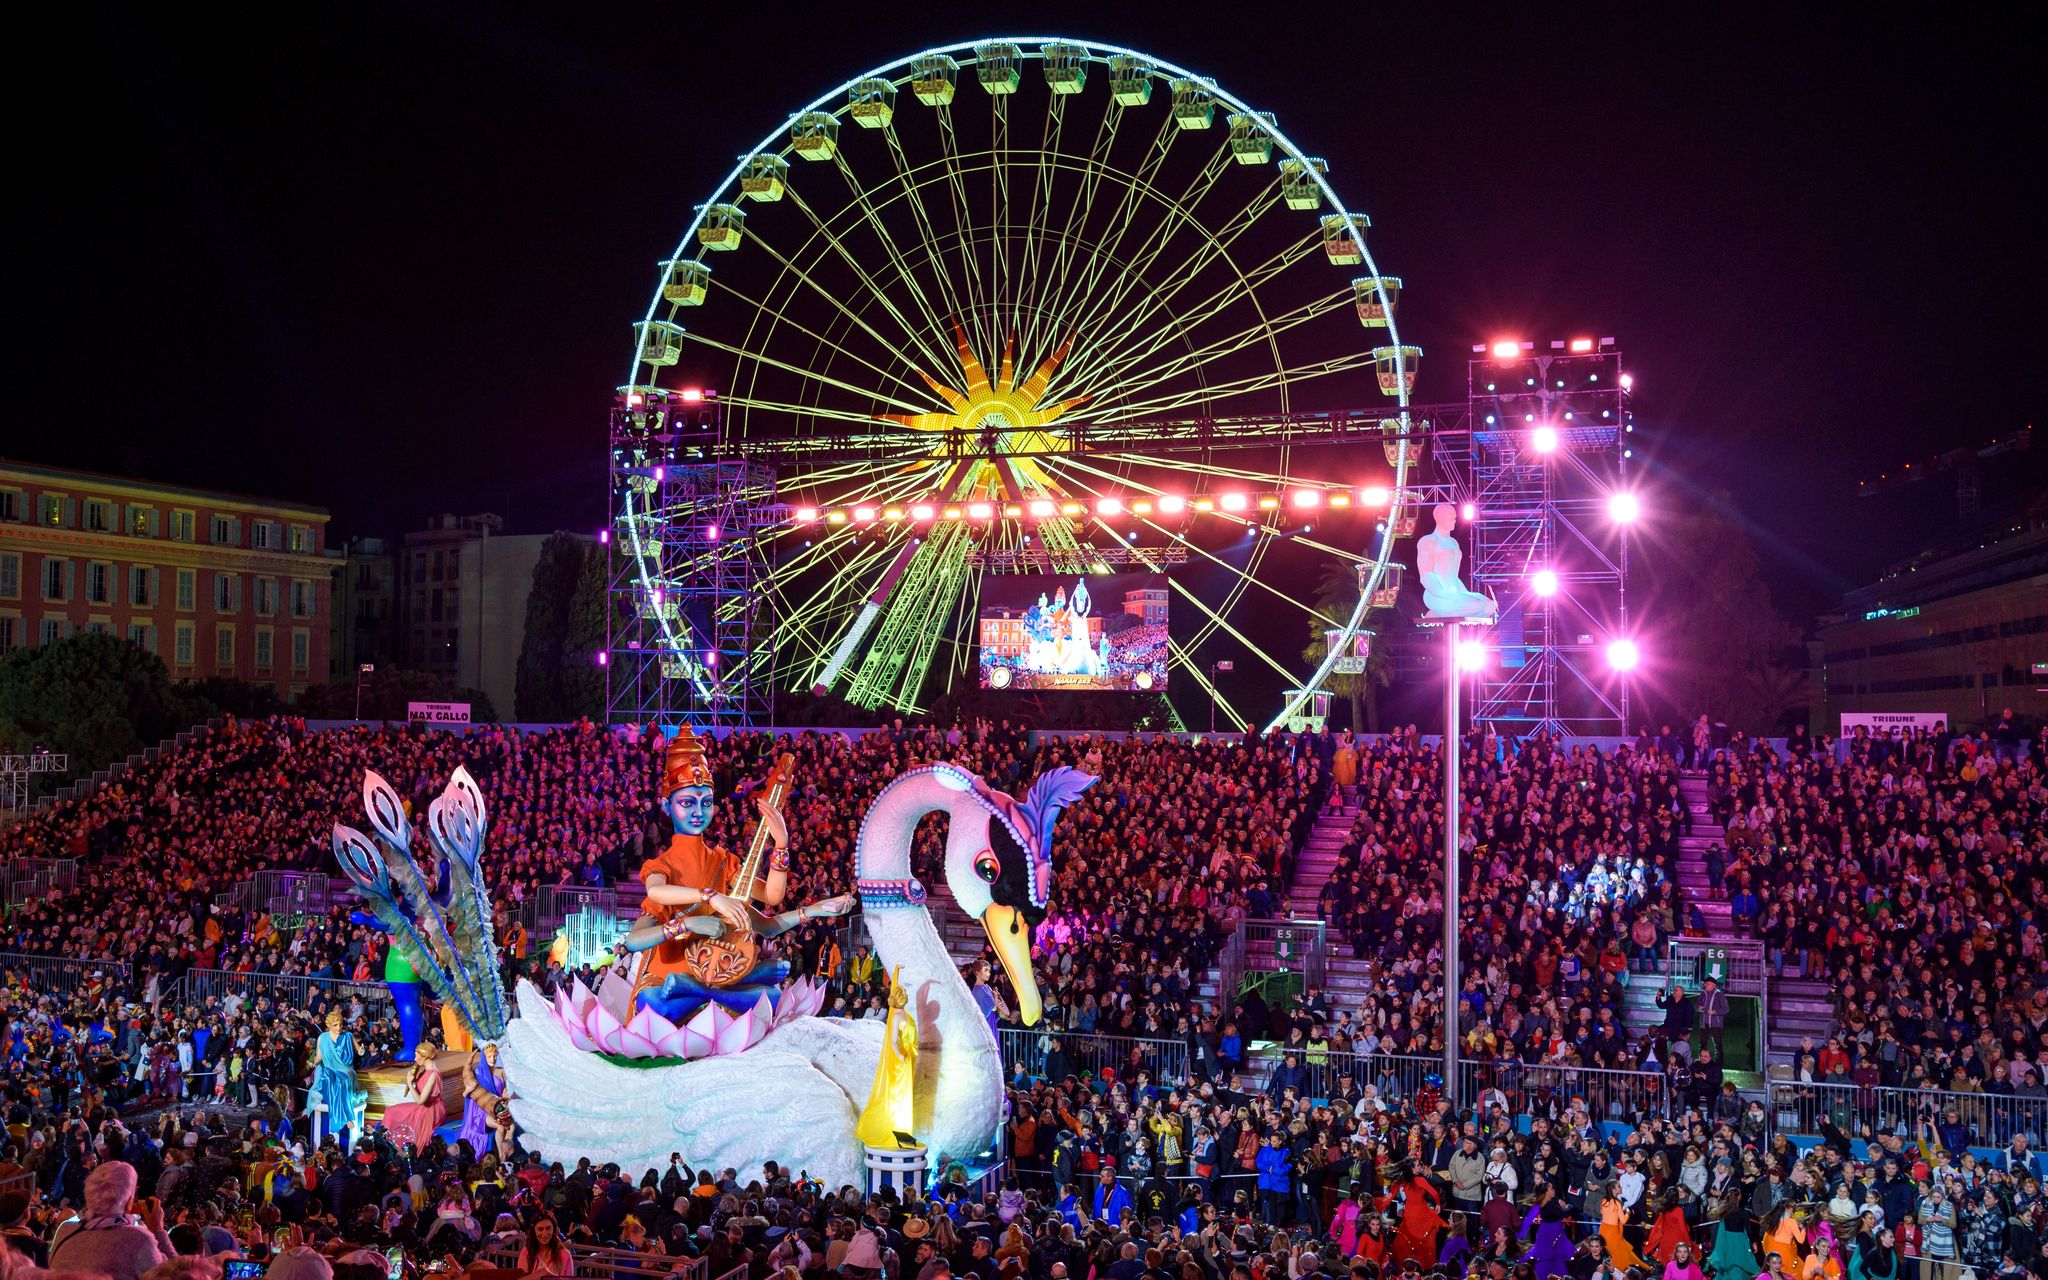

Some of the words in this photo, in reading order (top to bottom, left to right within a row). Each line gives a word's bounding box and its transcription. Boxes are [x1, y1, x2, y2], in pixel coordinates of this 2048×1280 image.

[410, 711, 433, 720] MAX
[435, 711, 469, 721] GALLO
[1872, 715, 1915, 723] TRIBUNE
[1889, 725, 1937, 736] GALL
